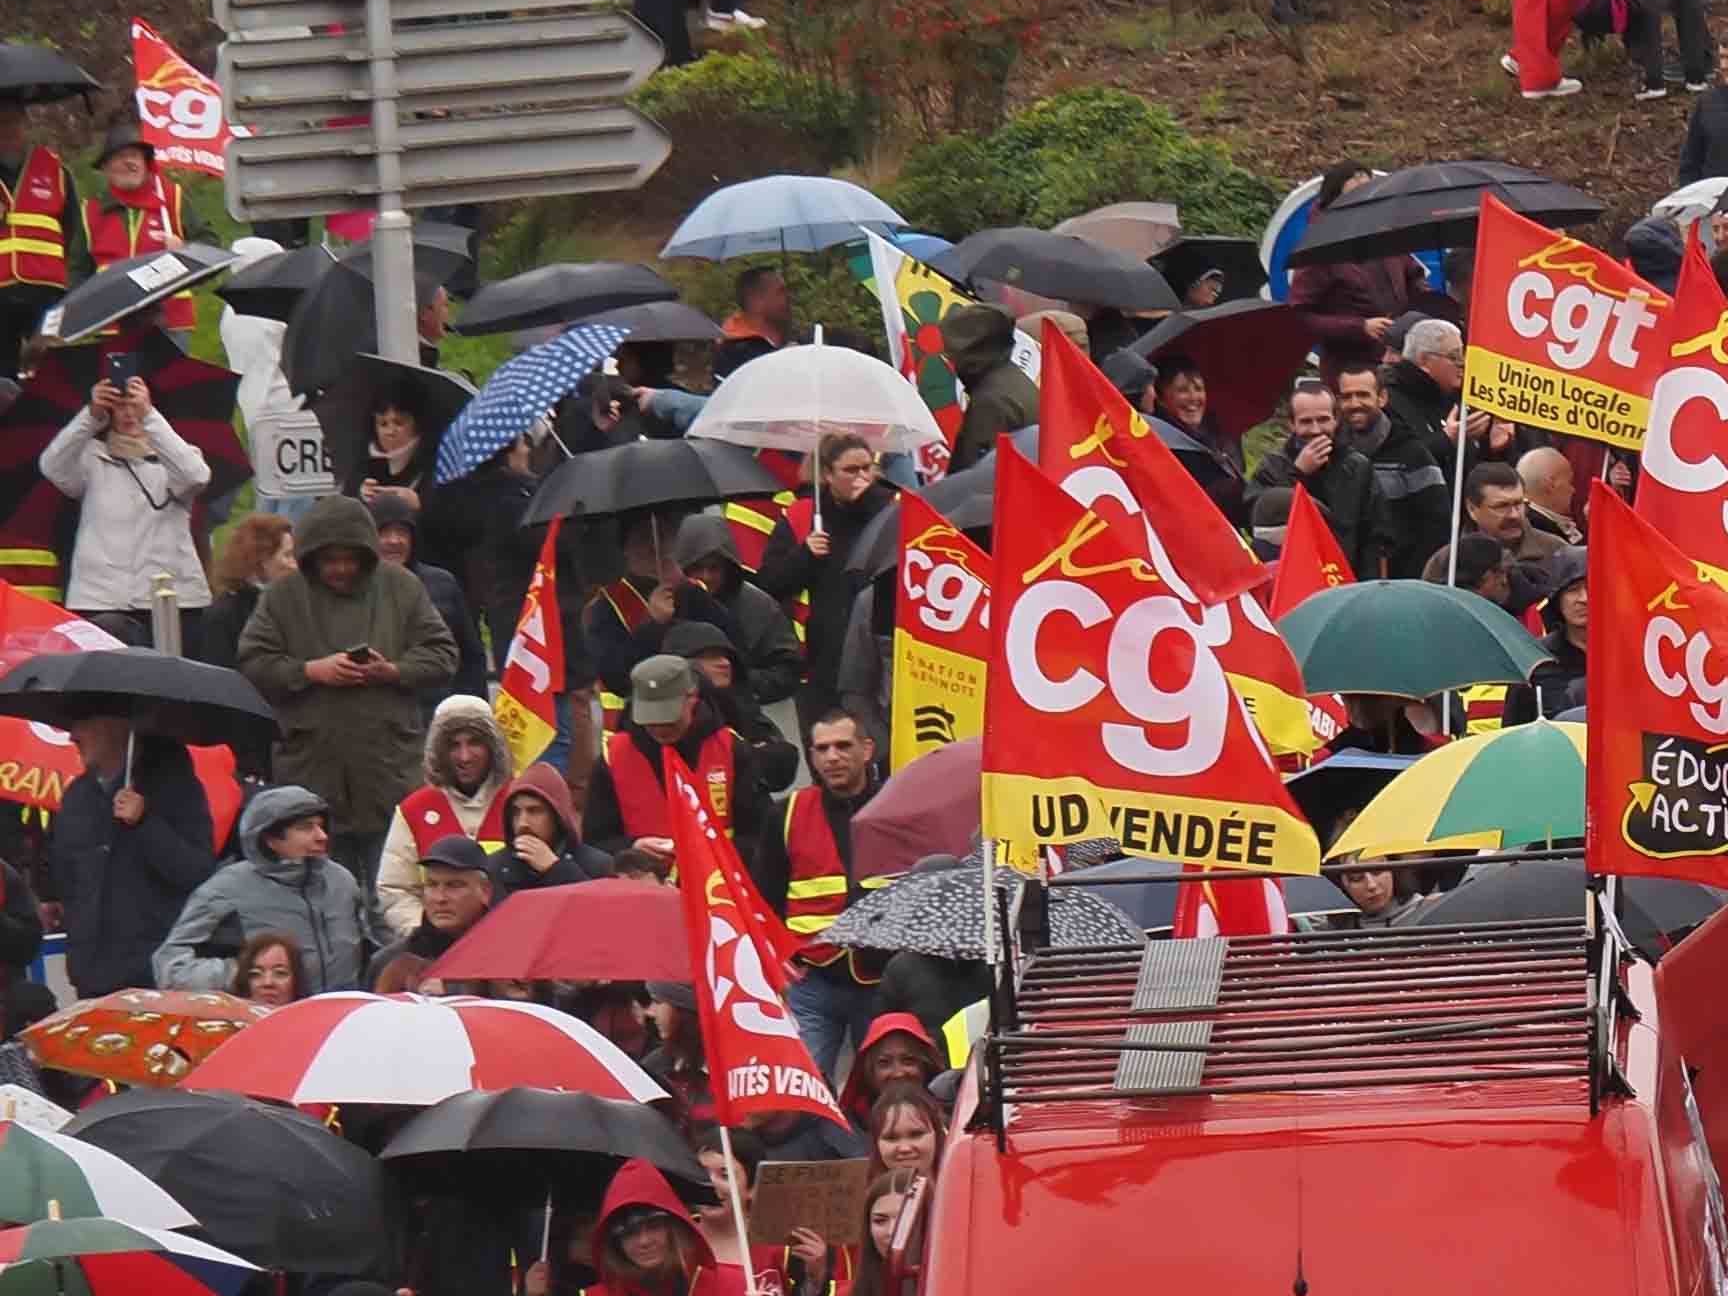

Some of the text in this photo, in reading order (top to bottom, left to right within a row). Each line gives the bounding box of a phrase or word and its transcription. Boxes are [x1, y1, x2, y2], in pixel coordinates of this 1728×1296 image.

[136, 86, 224, 139] cg
[1508, 271, 1657, 369] cgt
[1470, 376, 1495, 401] Les
[1497, 386, 1560, 421] Sables
[1499, 362, 1631, 416] Union Locale
[1005, 581, 1232, 777] cg
[1031, 793, 1090, 837] UD
[706, 916, 799, 1040] cg
